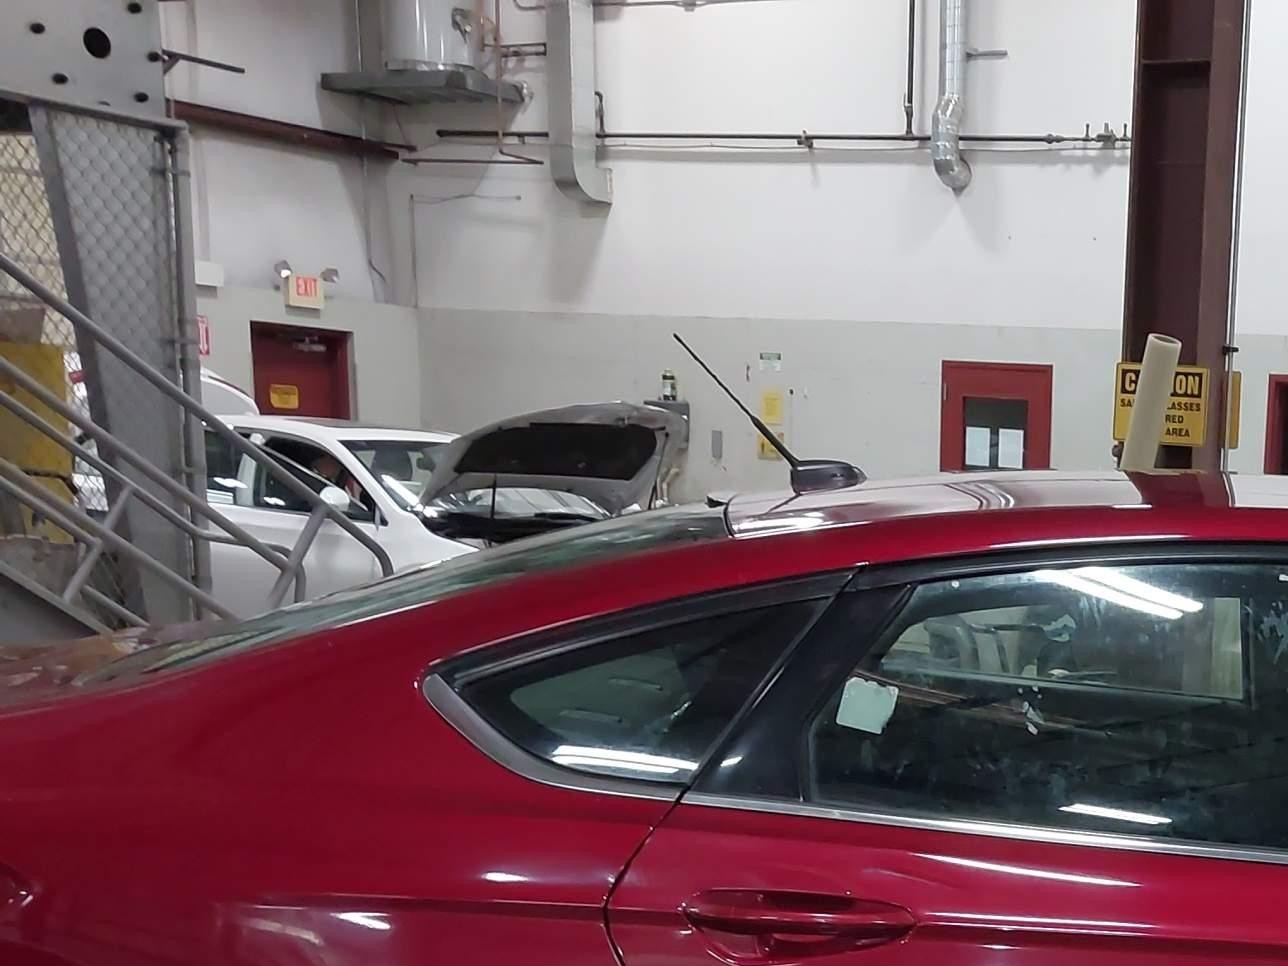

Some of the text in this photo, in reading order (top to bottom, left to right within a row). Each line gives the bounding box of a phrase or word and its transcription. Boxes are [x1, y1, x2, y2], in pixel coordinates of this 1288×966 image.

[296, 276, 318, 297] EXIT
[1167, 401, 1201, 412] ASSES
[1165, 428, 1190, 438] AREA
